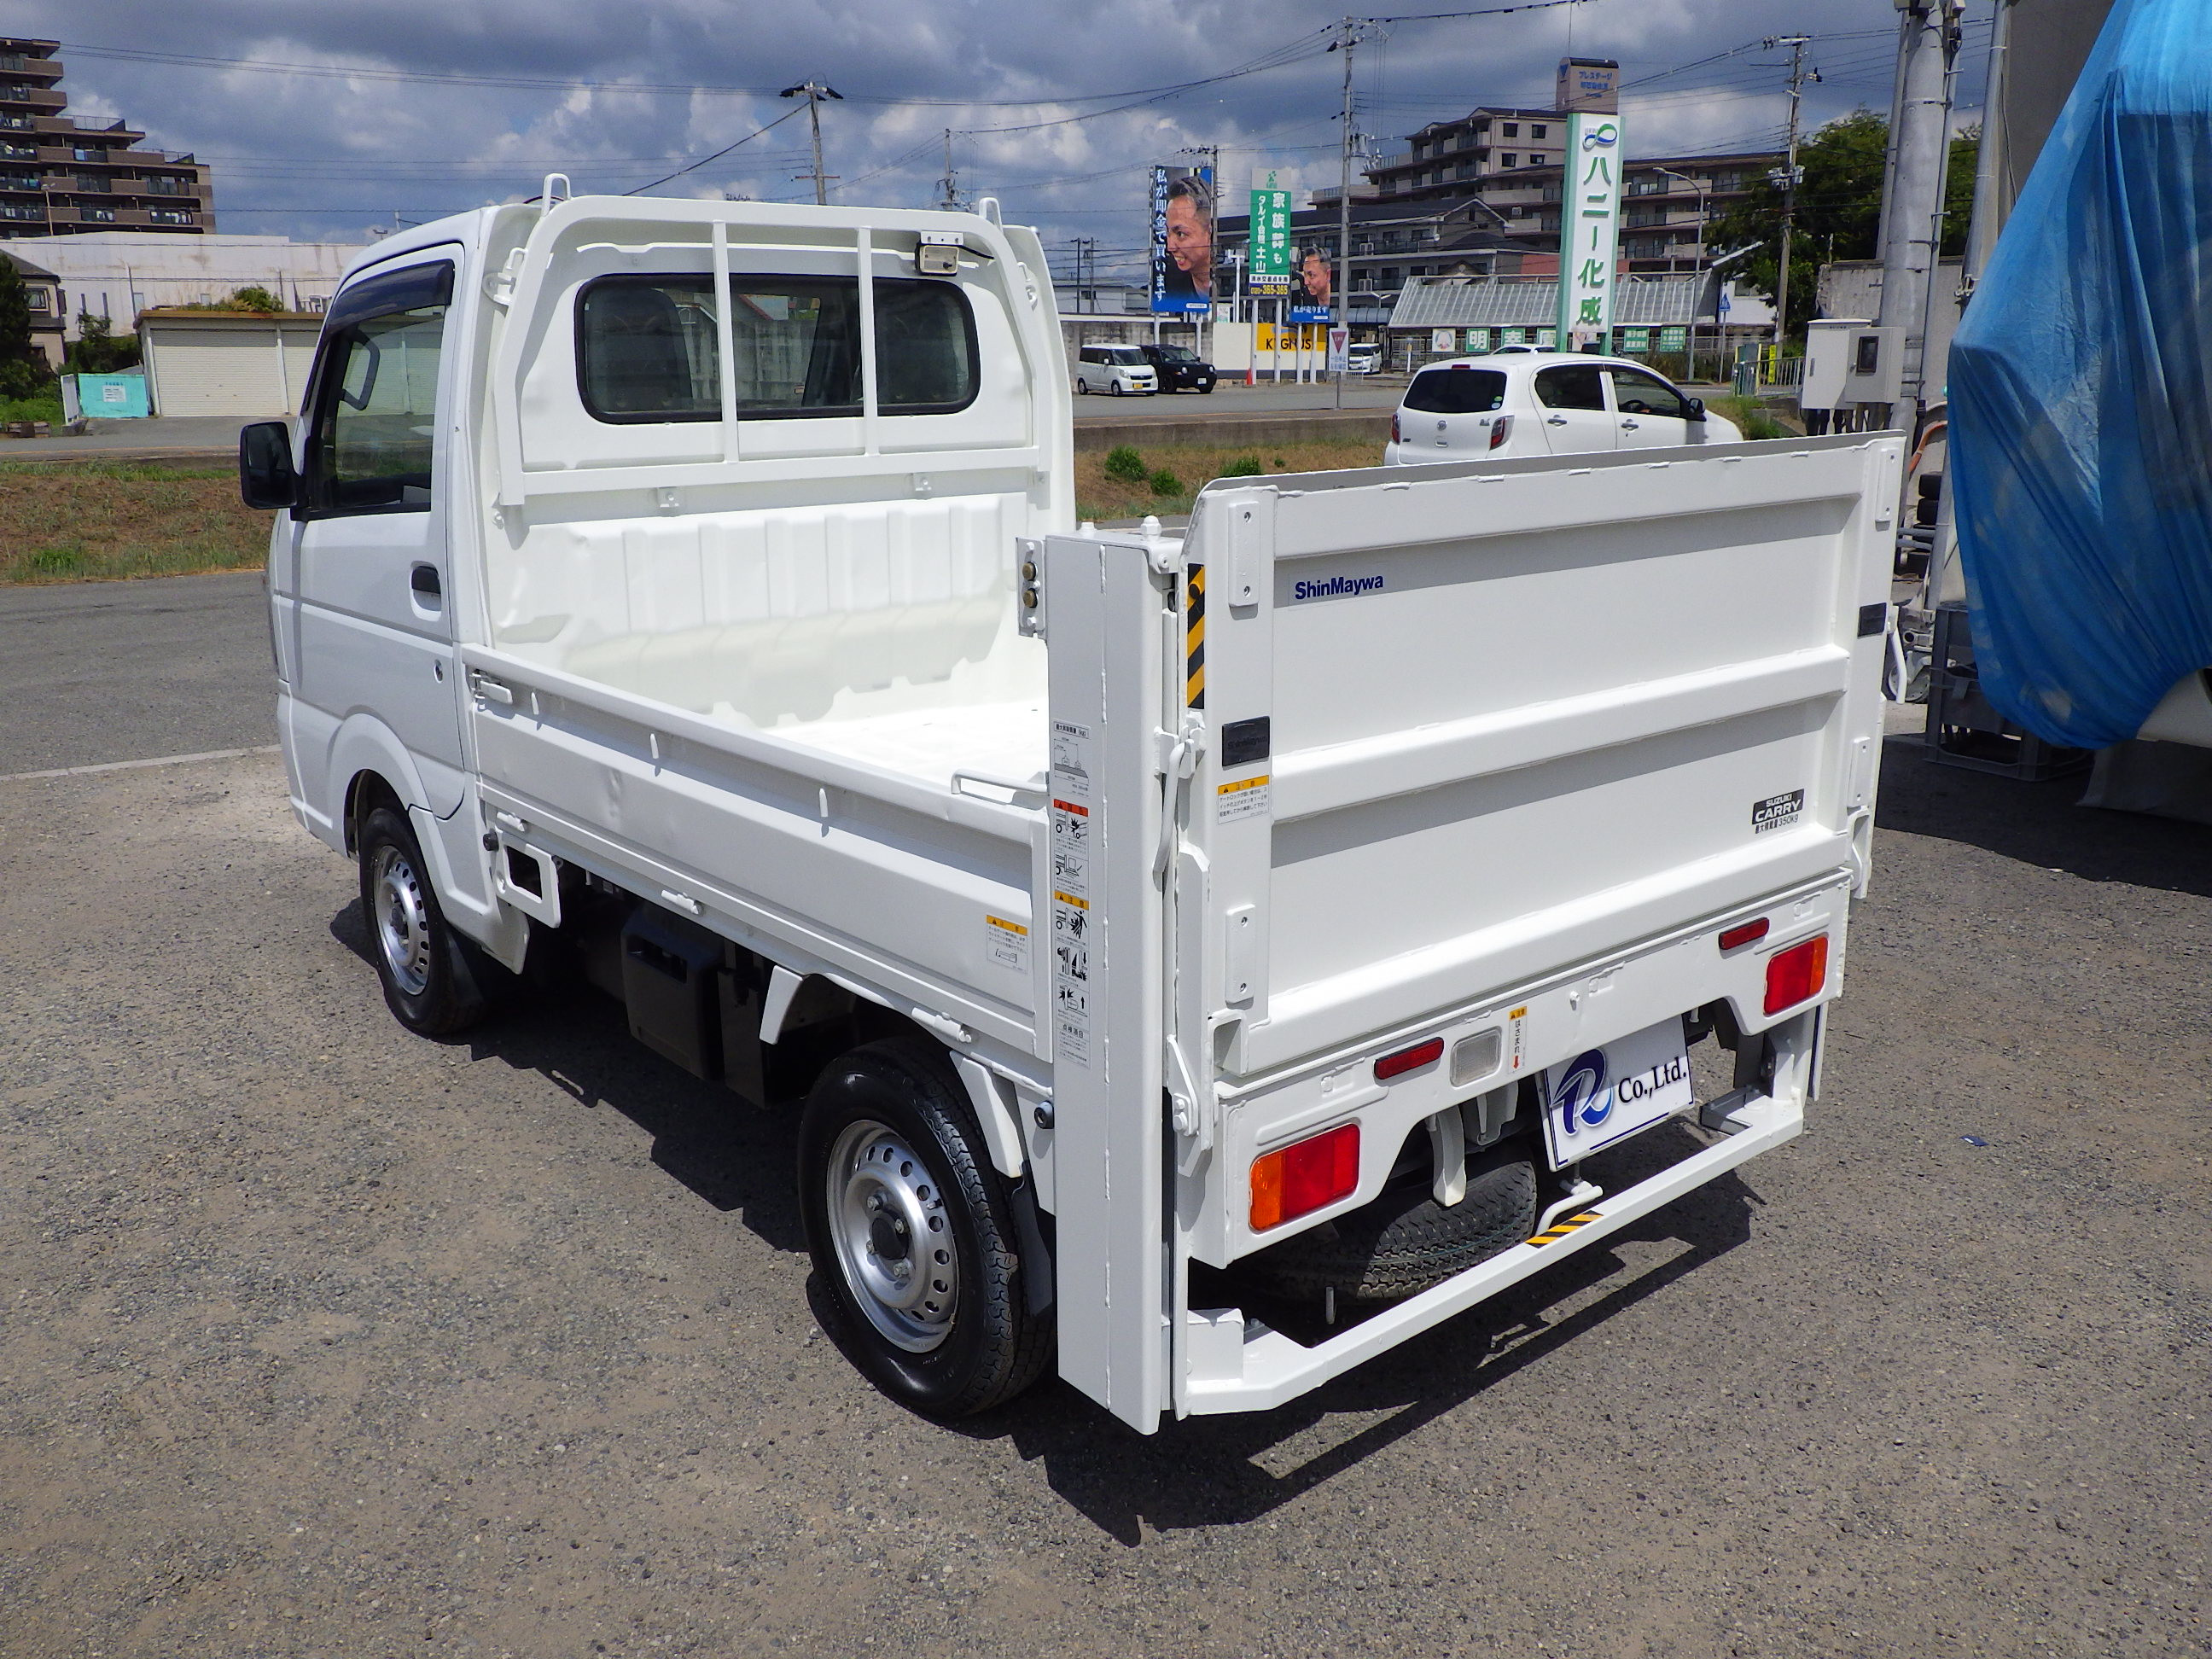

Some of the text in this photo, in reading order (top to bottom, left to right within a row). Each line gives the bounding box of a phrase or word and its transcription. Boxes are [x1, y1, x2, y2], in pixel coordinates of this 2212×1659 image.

[1155, 168, 1167, 302] 私が即金で買います
[1577, 155, 1611, 325] ハニー化成
[1293, 305, 1326, 314] 私が売ります
[1266, 338, 1312, 350] KGNUS
[1295, 575, 1384, 600] ShinMaywa
[1755, 799, 1802, 823] CARRY
[1766, 793, 1792, 807] SUZUKI
[1062, 1023, 1084, 1039] 点検項目
[1618, 1056, 1687, 1103] Co.,Ltd.
